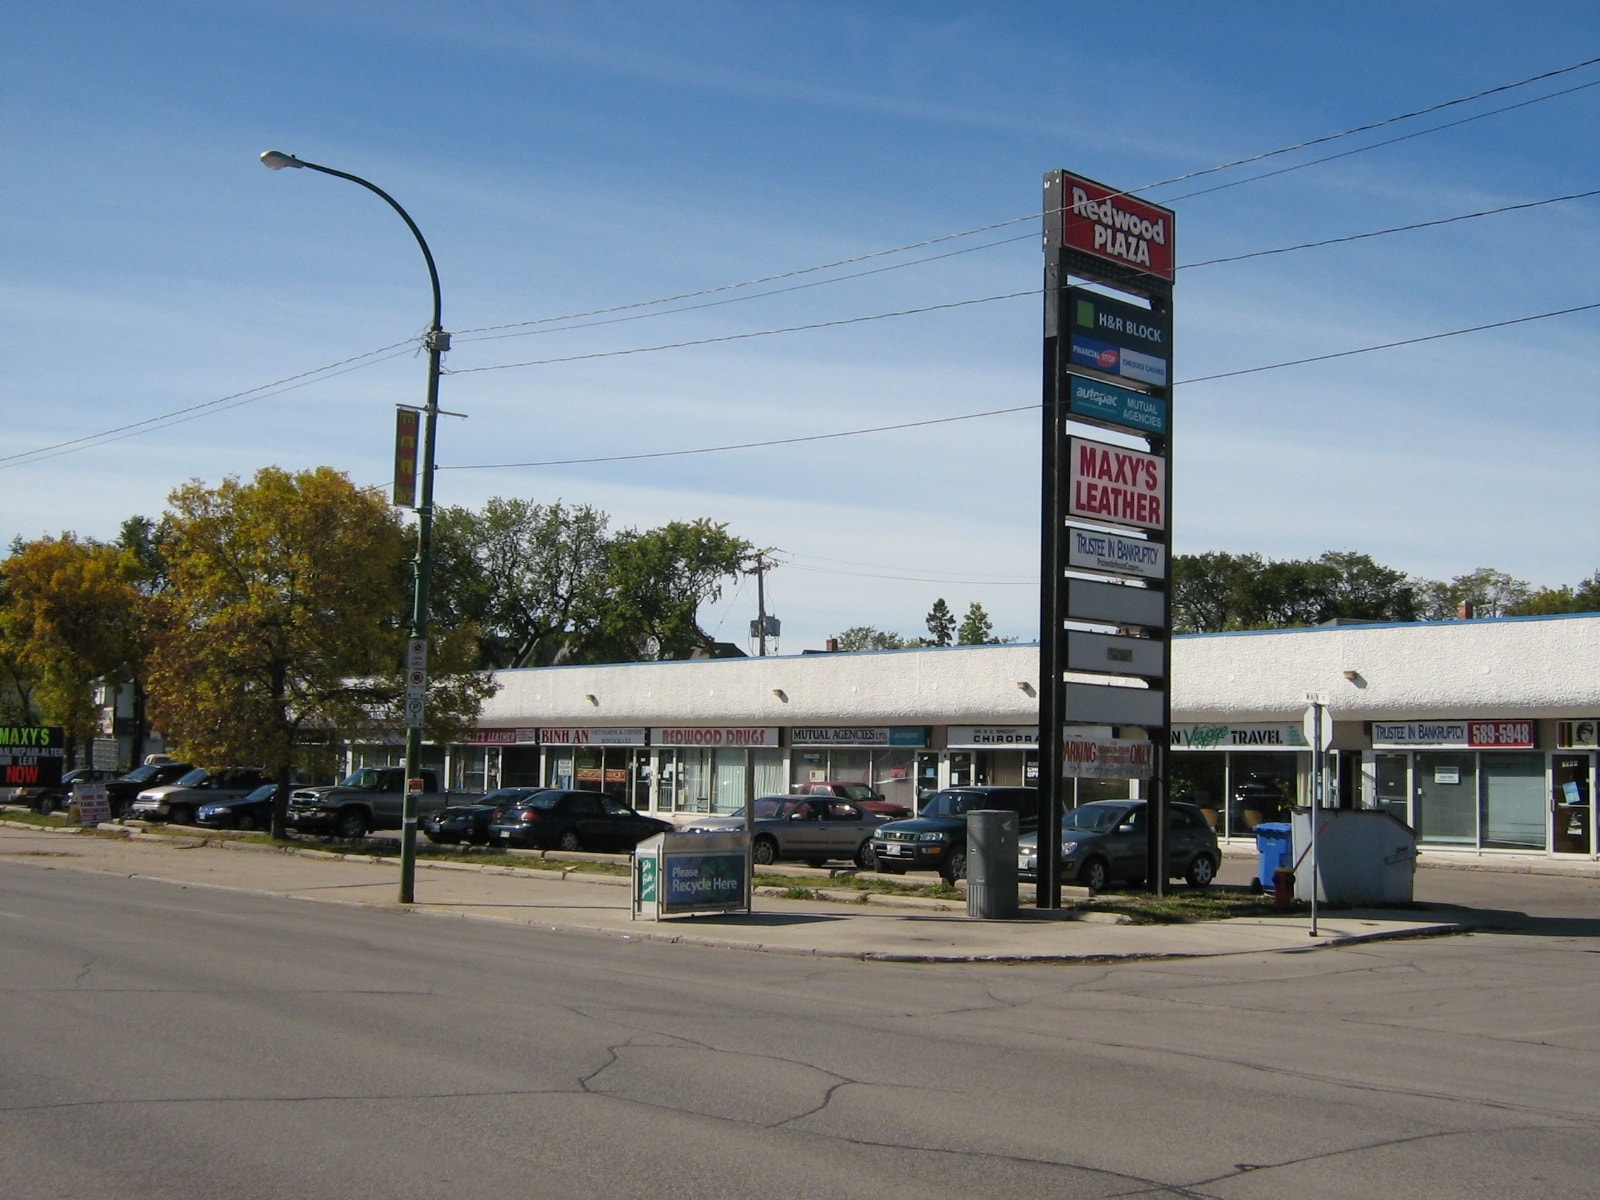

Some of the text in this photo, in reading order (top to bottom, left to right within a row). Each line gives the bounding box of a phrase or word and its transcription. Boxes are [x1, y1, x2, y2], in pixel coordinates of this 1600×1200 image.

[1072, 186, 1166, 246] Redwood
[1094, 223, 1152, 268] PLAZA
[1099, 311, 1162, 343] H&R BLOCK
[1076, 386, 1119, 407] autopac
[1126, 397, 1158, 415] MUTUAL
[1122, 409, 1162, 428] AGENCIES
[1080, 444, 1158, 492] MAXY'S
[1075, 480, 1161, 526] LEATHER
[1076, 532, 1106, 556] TRUSTEE
[1107, 538, 1115, 558] IN
[1116, 540, 1159, 566] BANKRUPTCY
[541, 728, 570, 744] BINH
[572, 729, 590, 744] AN
[662, 729, 766, 745] REDWOOD DRUGS
[793, 729, 832, 740] MUTUAL
[832, 729, 875, 740] AGENCIES
[1184, 725, 1229, 749] Voyage
[1231, 730, 1283, 745] TRAVEL
[1375, 724, 1465, 740] TRUSTEE IN BANKRUPTCY
[1472, 724, 1530, 744] 589-5948
[1063, 741, 1097, 763] ARKING
[1130, 744, 1152, 766] ONLY
[6, 765, 39, 784] NOW
[672, 867, 699, 877] Please
[672, 876, 738, 894] Recycle Here
